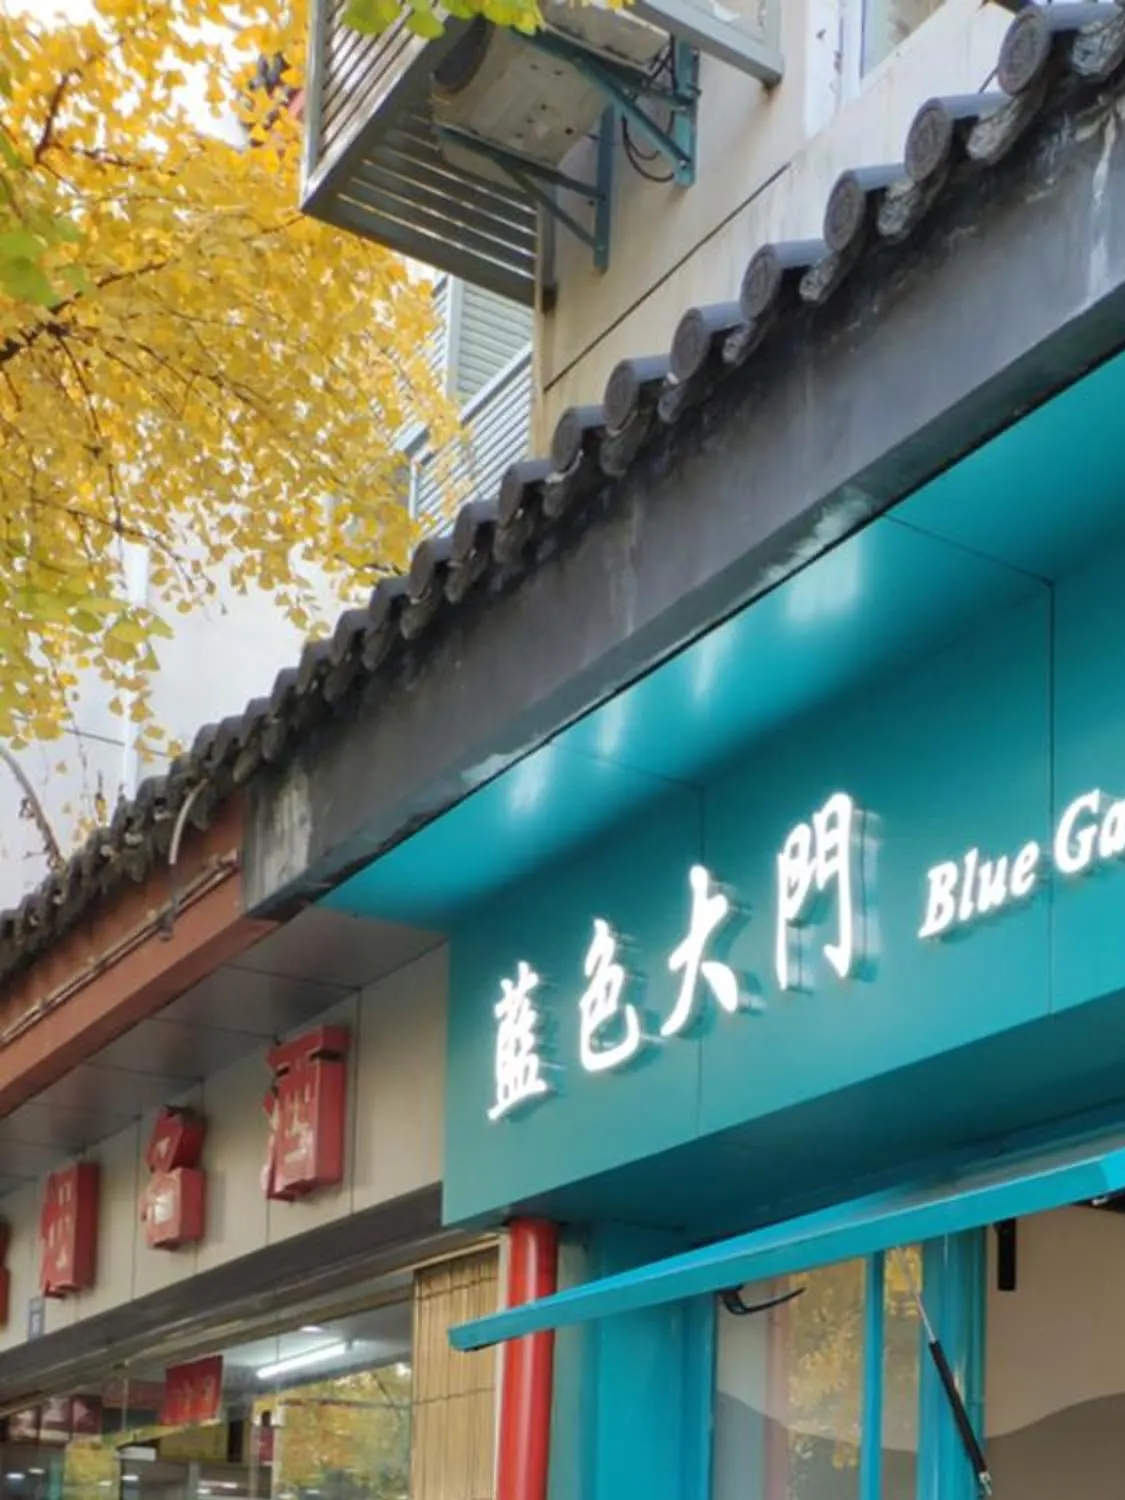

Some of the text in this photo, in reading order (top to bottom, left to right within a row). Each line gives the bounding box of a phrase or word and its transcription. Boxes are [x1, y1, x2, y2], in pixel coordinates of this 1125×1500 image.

[487, 792, 854, 1121] 藍色大門
[918, 843, 1040, 938] Blue
